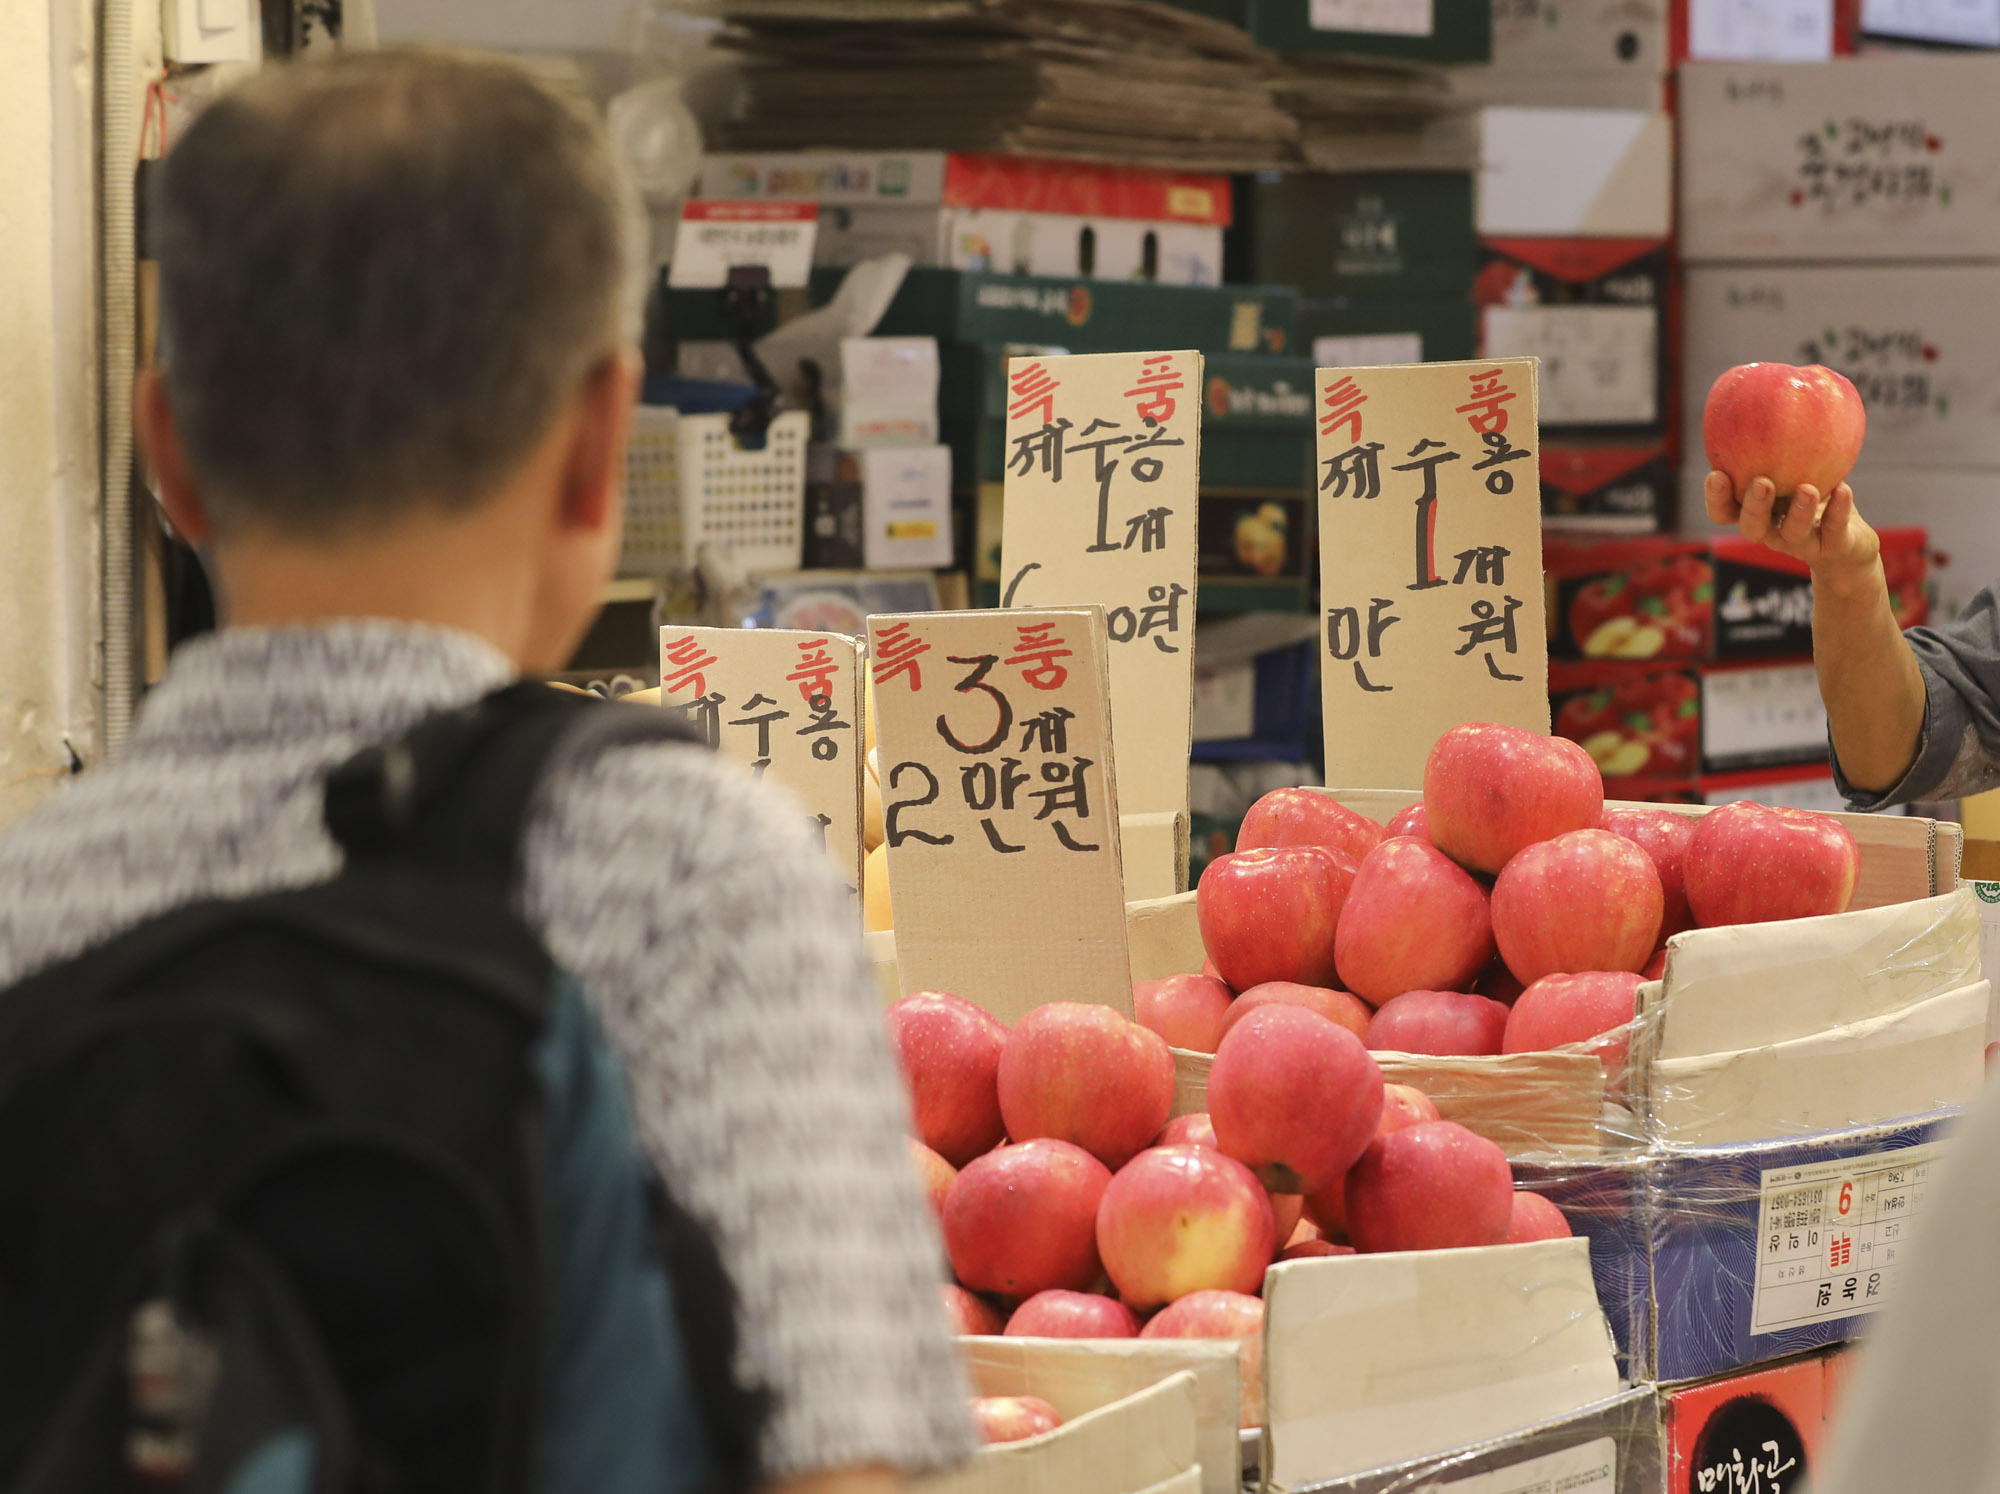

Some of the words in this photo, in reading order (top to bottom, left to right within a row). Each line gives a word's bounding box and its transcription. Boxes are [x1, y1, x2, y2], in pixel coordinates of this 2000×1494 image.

[1009, 362, 1061, 425] 특
[1124, 355, 1184, 423] 품
[1319, 376, 1368, 444] 특
[1456, 369, 1517, 435] 품
[1007, 416, 1185, 483] 제수용
[1320, 438, 1531, 500] 제수용
[1086, 459, 1174, 553] 1개
[1406, 498, 1511, 590] 1개
[663, 635, 718, 699] 특
[786, 639, 839, 706] 품
[873, 622, 931, 692] 특
[1004, 622, 1073, 690] 품
[936, 655, 1075, 754] 3개
